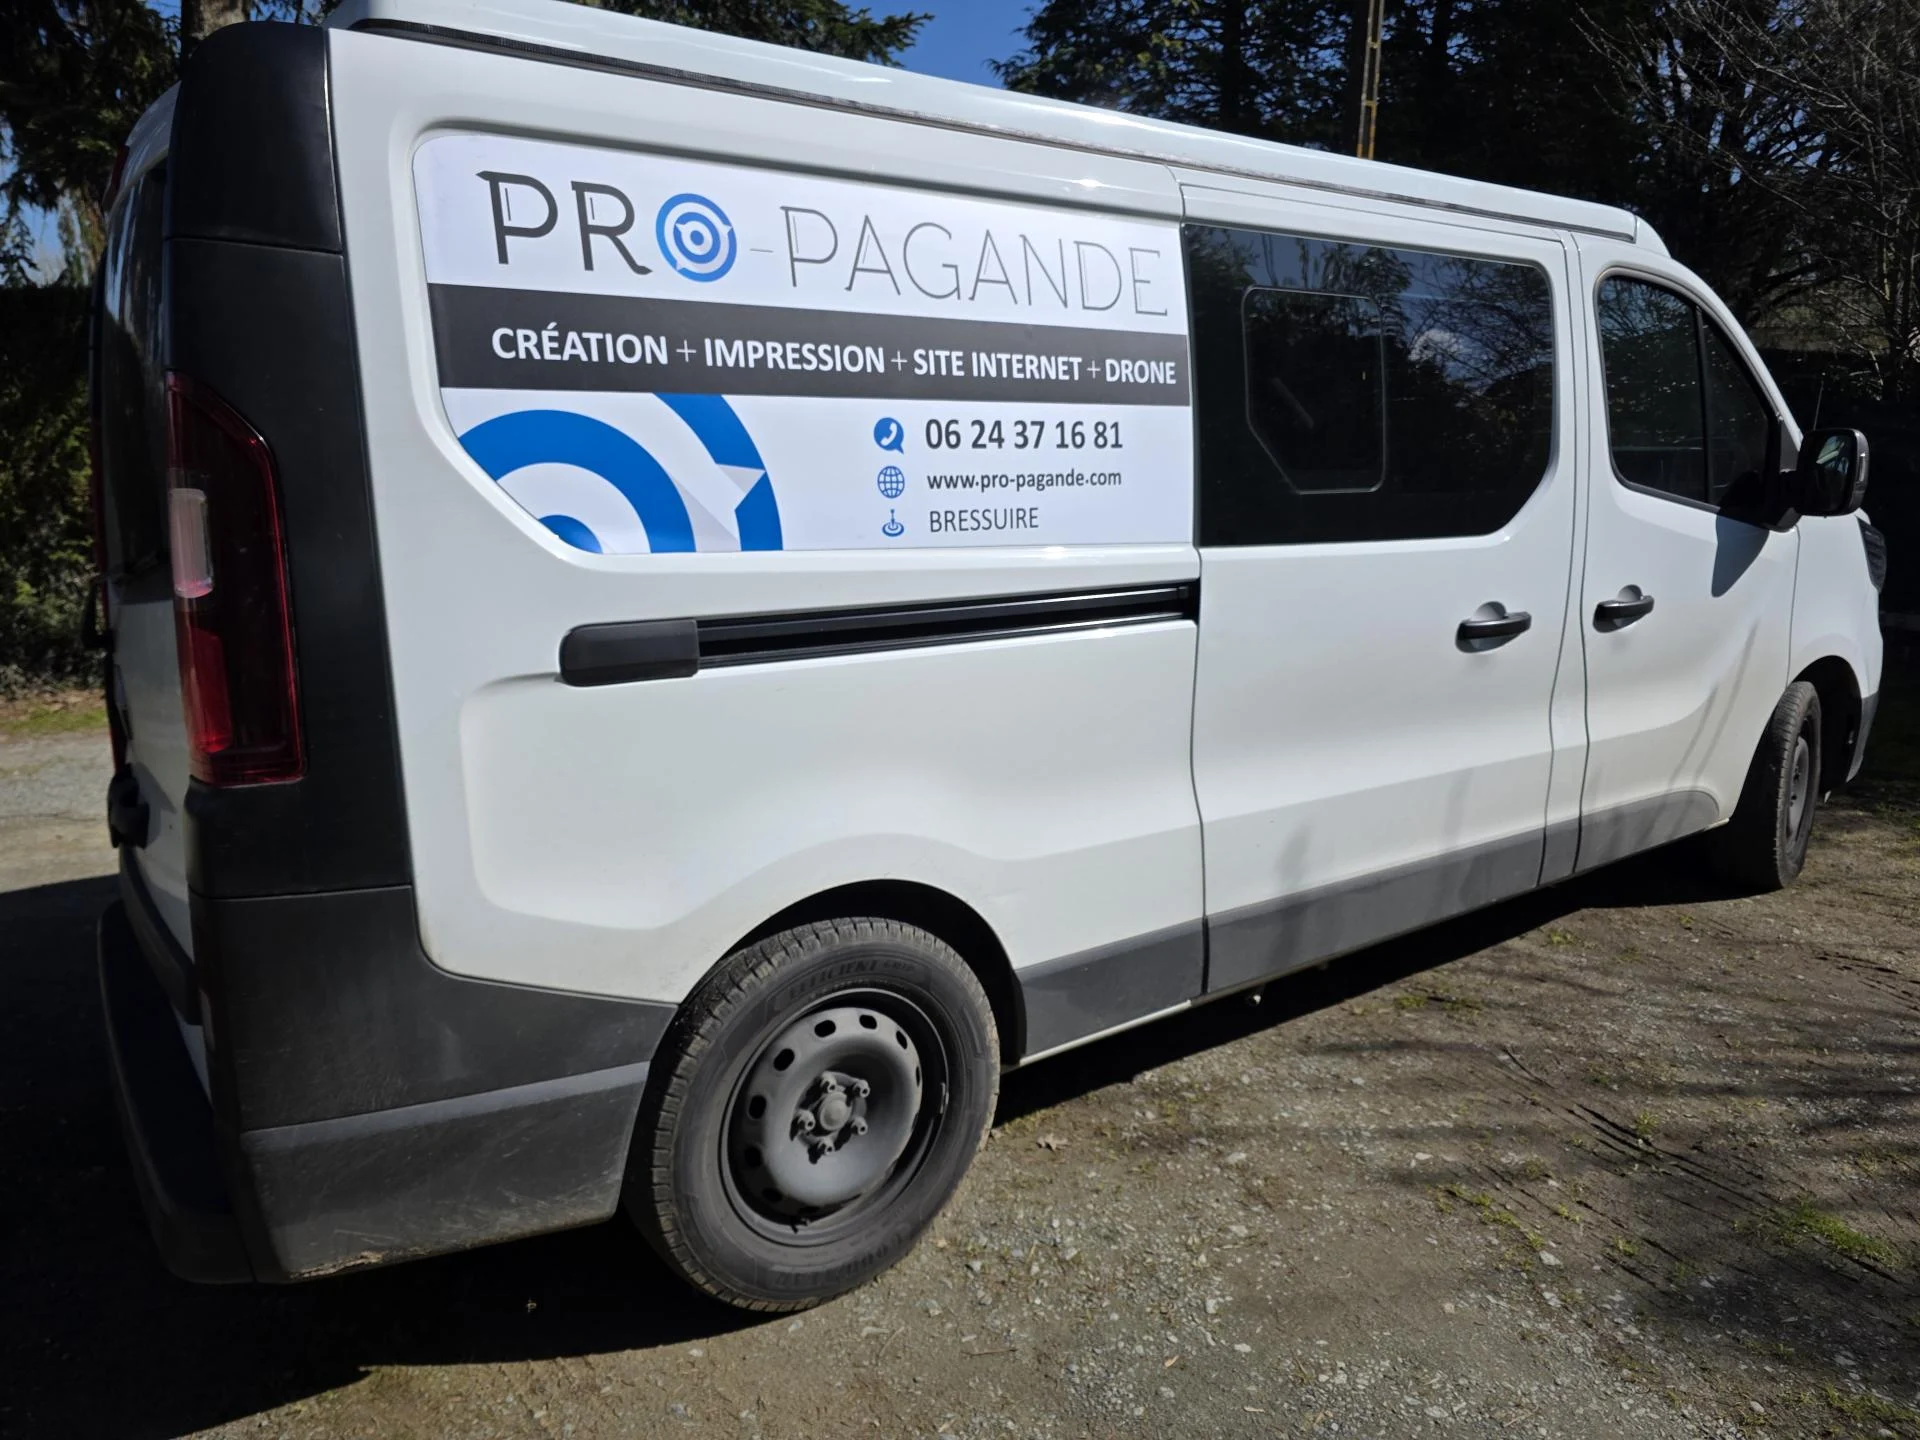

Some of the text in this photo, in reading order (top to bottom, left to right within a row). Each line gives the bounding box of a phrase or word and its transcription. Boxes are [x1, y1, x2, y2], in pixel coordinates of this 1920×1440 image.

[492, 322, 669, 365] CRÉATION
[704, 338, 884, 373] IMPRESSION
[913, 348, 965, 377] SITE
[971, 351, 1082, 381] INTERNET
[1105, 358, 1177, 385] DRONE
[925, 418, 1123, 449] 06 24 37 16 81
[927, 468, 1122, 493] www.pro-pagande.com
[929, 507, 1040, 533] BRESSUIRE
